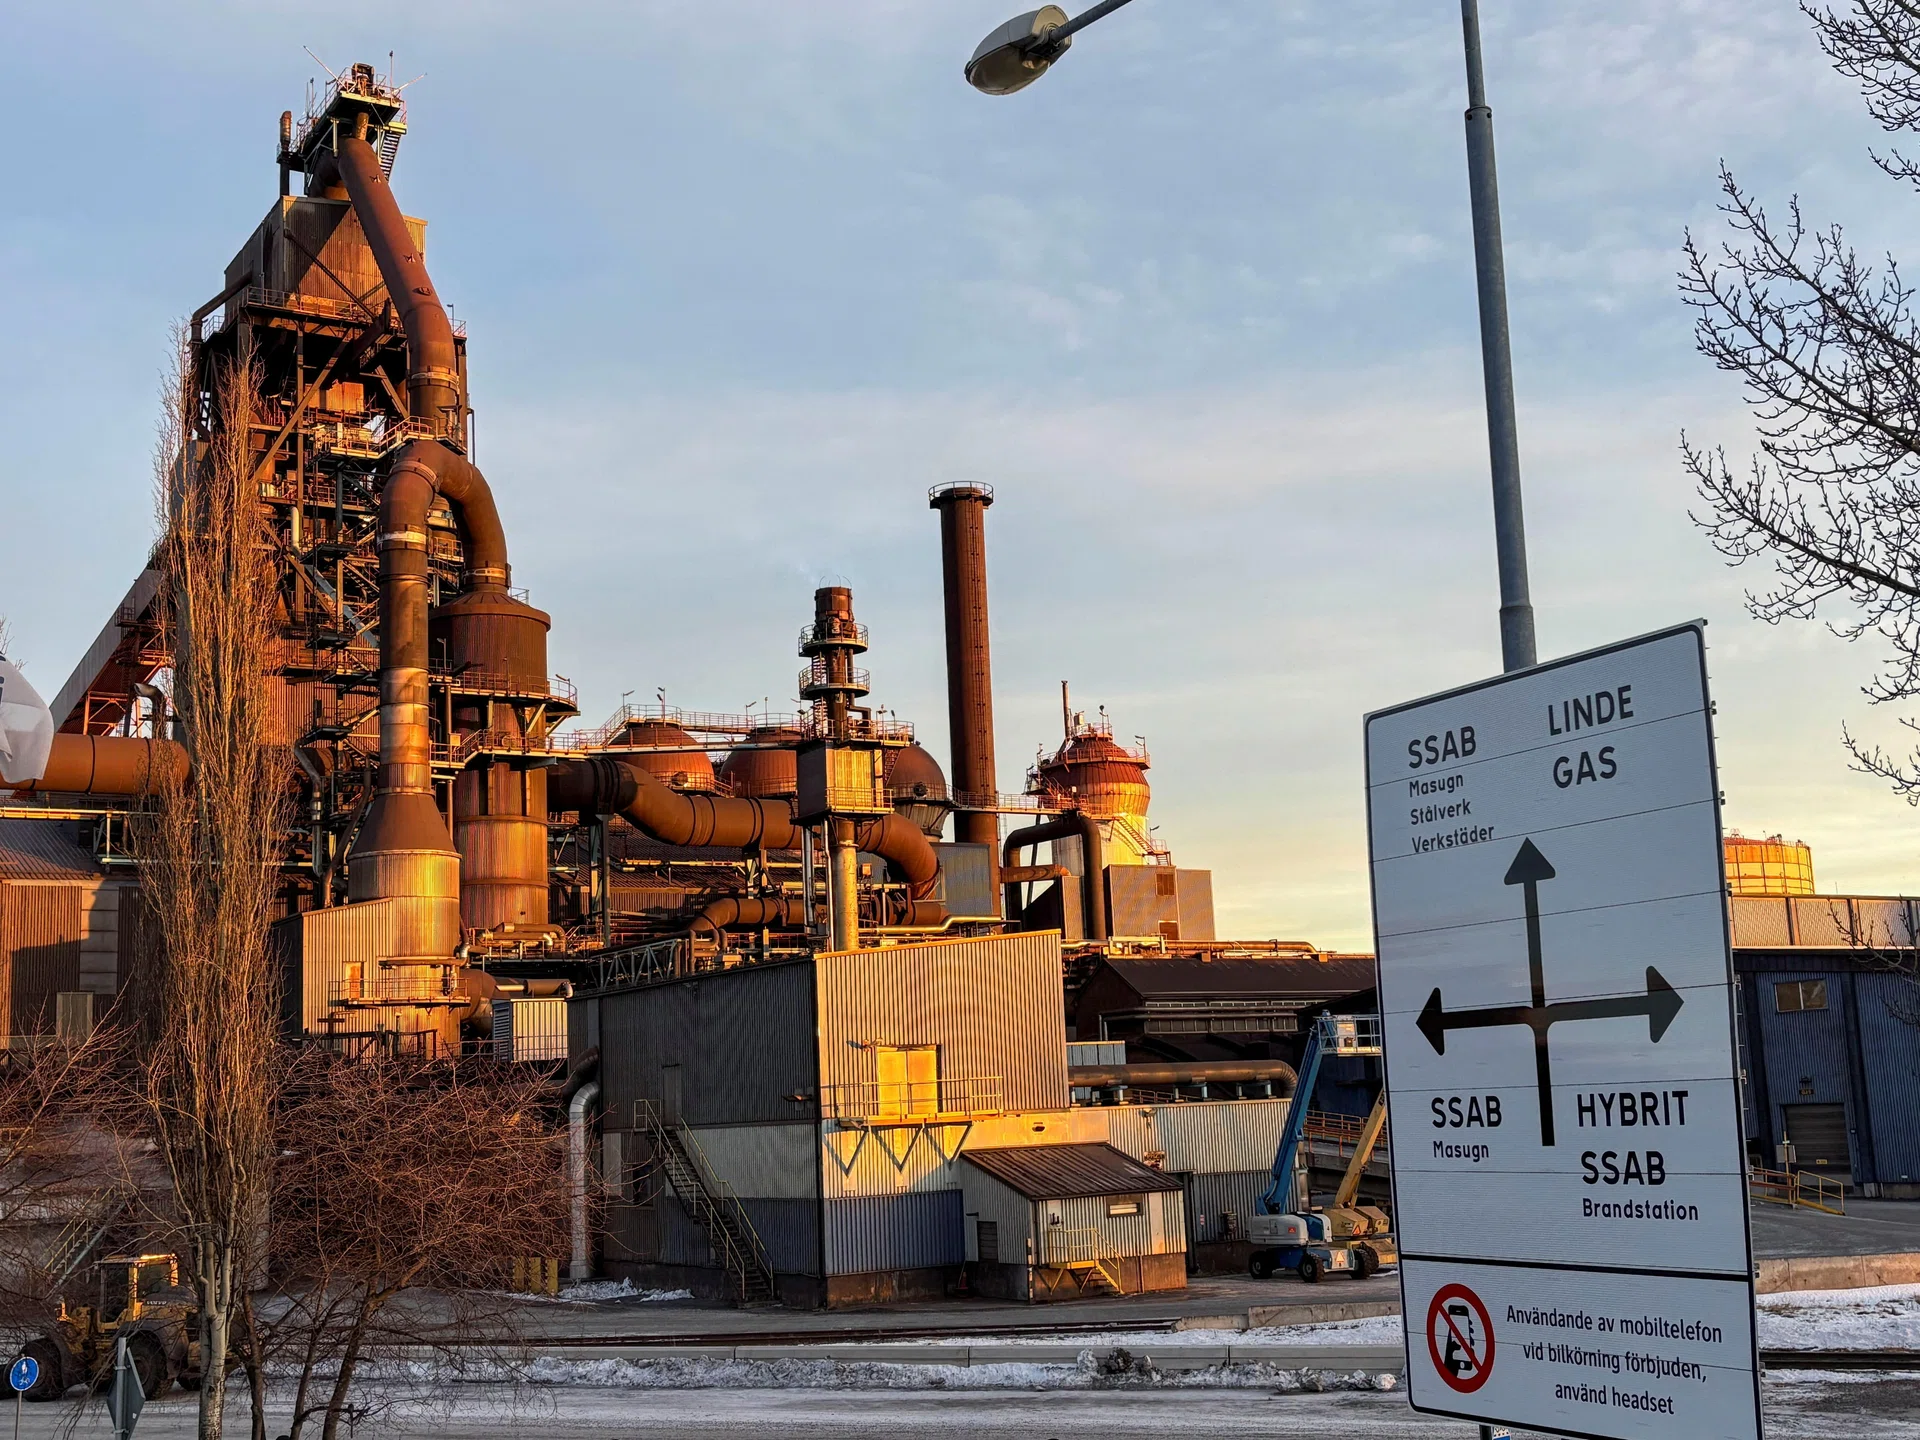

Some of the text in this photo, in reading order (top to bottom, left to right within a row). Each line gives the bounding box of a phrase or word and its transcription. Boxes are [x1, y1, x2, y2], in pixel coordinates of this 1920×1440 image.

[1547, 685, 1634, 736] LINDE
[1407, 726, 1476, 768] SSAB
[1552, 746, 1618, 788] GAS
[1409, 774, 1464, 798] Masugn
[1410, 798, 1472, 825] Stålverk
[1411, 824, 1495, 853] Verkstäder
[1430, 1095, 1502, 1128] SSAB
[1576, 1090, 1689, 1127] HYBRIT
[1432, 1140, 1489, 1162] Masugn
[1581, 1150, 1666, 1185] SSAB
[1583, 1197, 1699, 1221] Brandstation
[1506, 1304, 1722, 1343] Användande av mobiltelefon
[1523, 1342, 1707, 1382] vid bilkörning förbjuden,
[1555, 1382, 1675, 1414] använd headset
